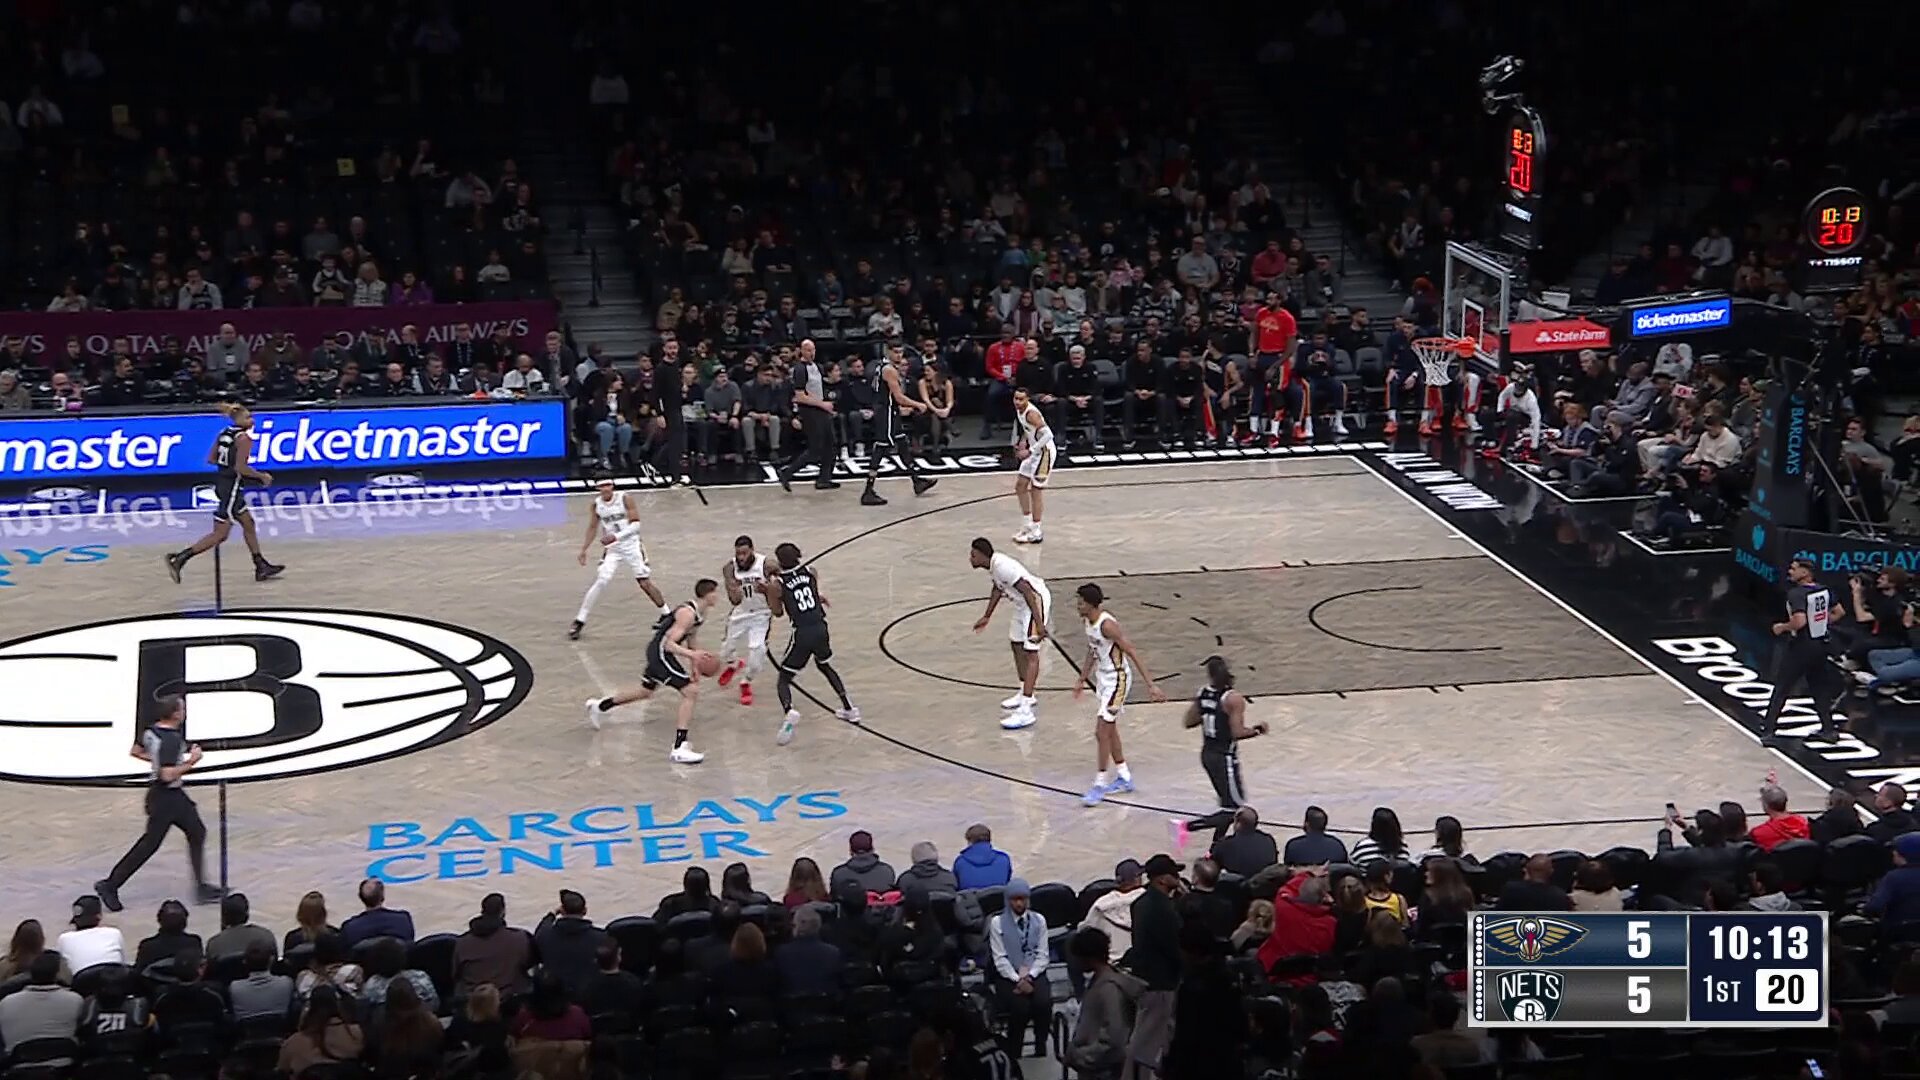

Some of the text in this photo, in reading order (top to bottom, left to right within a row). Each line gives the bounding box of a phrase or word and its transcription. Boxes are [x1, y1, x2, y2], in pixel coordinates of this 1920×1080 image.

[1819, 223, 1853, 245] 20
[1821, 206, 1861, 224] 10:13
[1637, 309, 1726, 329] ticketmaster
[247, 417, 541, 464] ticketmaster
[1785, 407, 1805, 477] BARCLAYS
[794, 586, 816, 613] 33
[135, 633, 323, 753] B
[366, 790, 848, 851] BARCLAYS
[365, 830, 771, 884] CENTER
